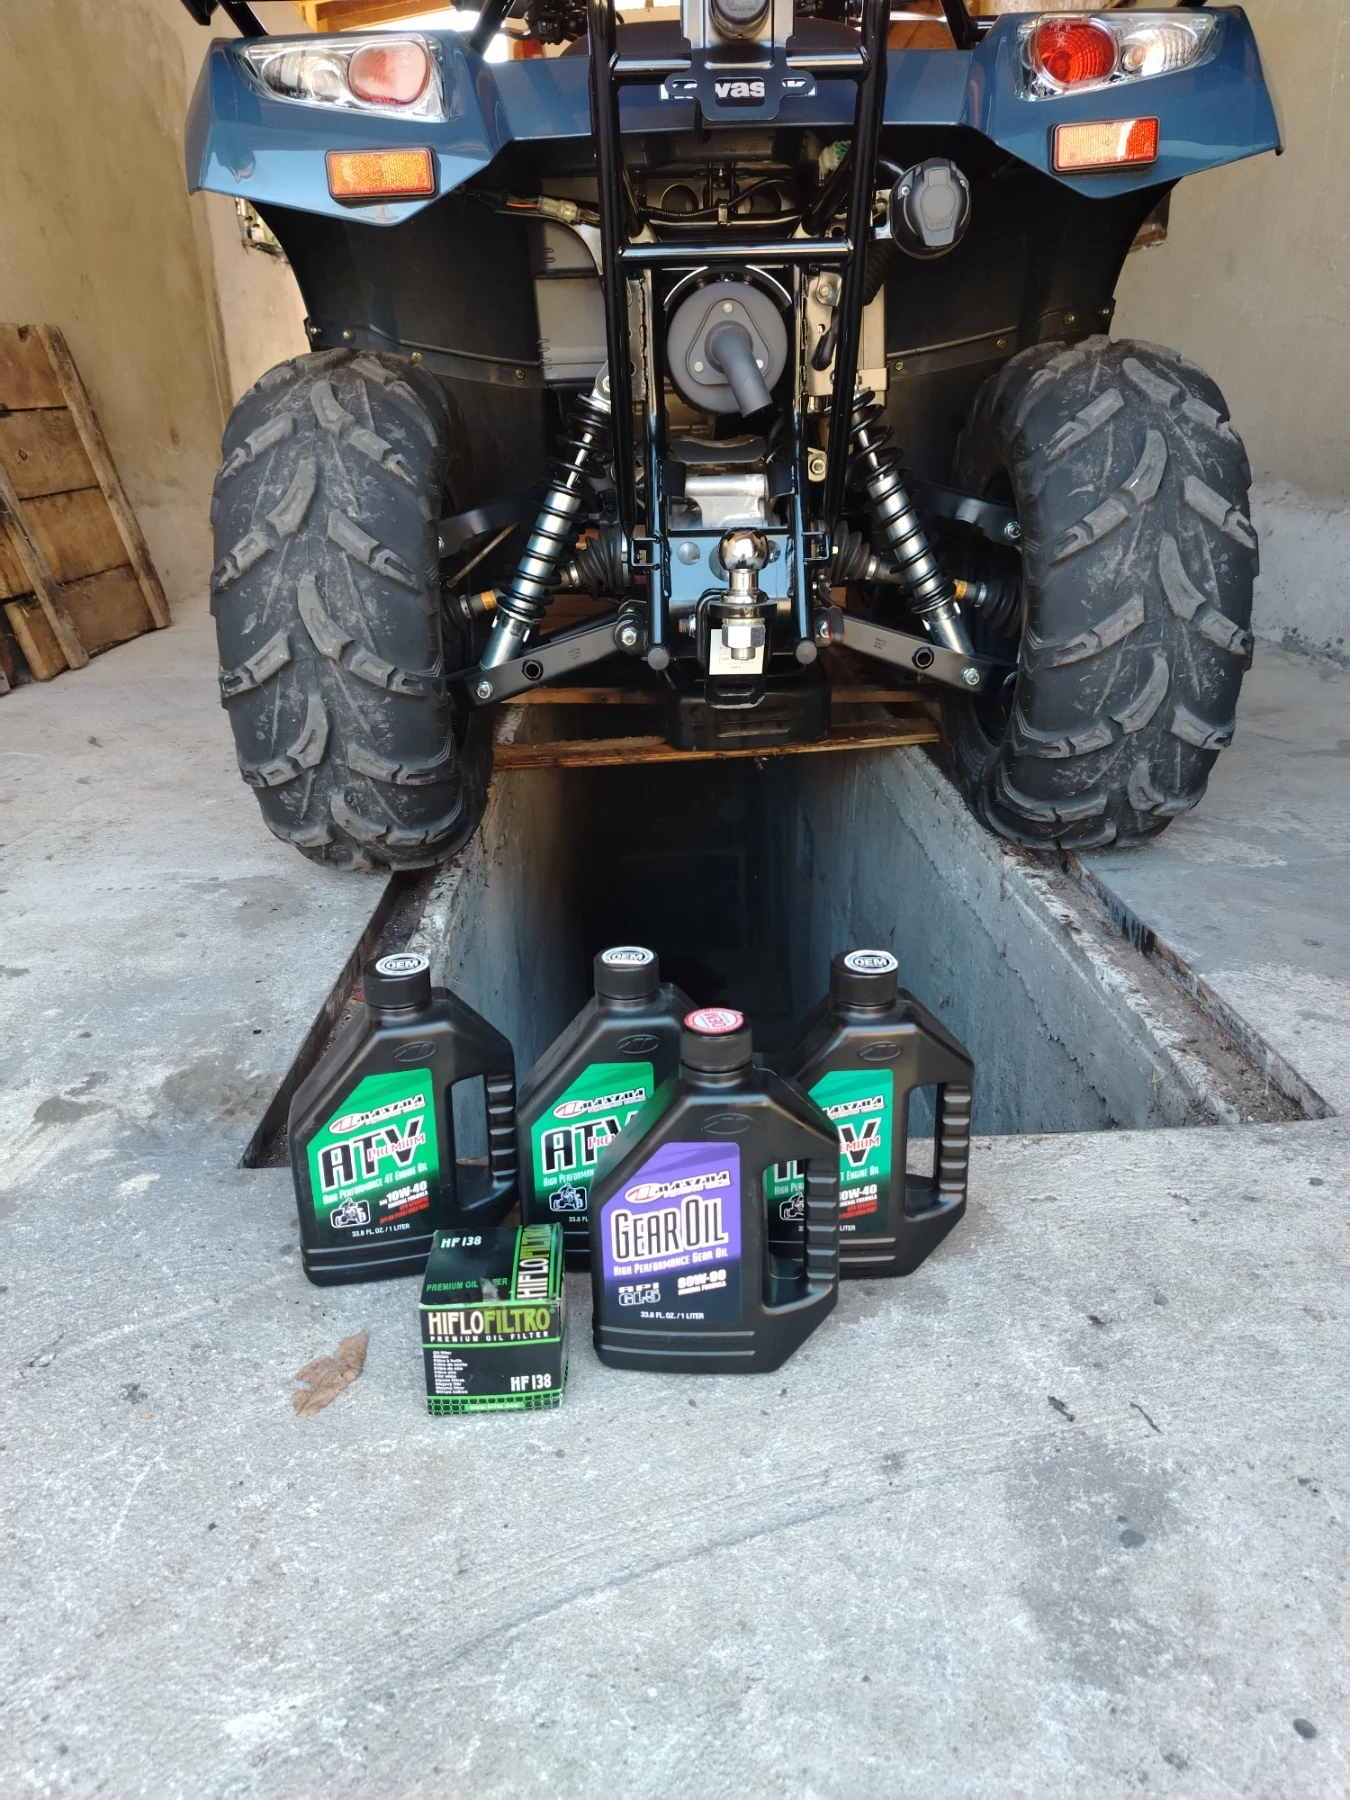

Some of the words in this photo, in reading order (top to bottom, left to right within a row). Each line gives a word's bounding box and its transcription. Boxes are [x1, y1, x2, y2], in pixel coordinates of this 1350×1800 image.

[386, 960, 419, 969] OEM
[611, 952, 644, 962] OEM
[854, 958, 888, 966] OEM
[367, 1133, 425, 1162] PREMIUM
[839, 1135, 881, 1154] EMIUM
[318, 1115, 425, 1193] ATV
[543, 1176, 558, 1187] HIGH
[558, 1169, 595, 1184] PERFORMAN
[846, 1168, 868, 1181] ENGINE
[869, 1165, 879, 1175] OIL
[386, 1180, 428, 1202] 10W-40
[774, 1183, 789, 1196] HIGH
[393, 1223, 410, 1232] LITER
[613, 1210, 682, 1260] GEAR
[684, 1197, 726, 1247] OIL
[440, 1237, 460, 1249] HF
[461, 1235, 482, 1247] 138
[613, 1264, 633, 1276] HIGH
[634, 1254, 690, 1273] PERFORMANCE
[692, 1250, 713, 1264] GEAR
[715, 1247, 729, 1258] OIL
[426, 1281, 463, 1292] PREMIUM
[465, 1280, 479, 1289] OIL
[617, 1282, 660, 1294] API
[428, 1308, 551, 1335] HIFLOFILTRO
[640, 1311, 655, 1319] 33.8
[685, 1312, 704, 1320] LITER
[429, 1335, 479, 1343] PREMIUM
[485, 1334, 504, 1342] OIL
[510, 1331, 549, 1340] FILTER
[510, 1376, 530, 1392] HF
[531, 1373, 552, 1390] 138
